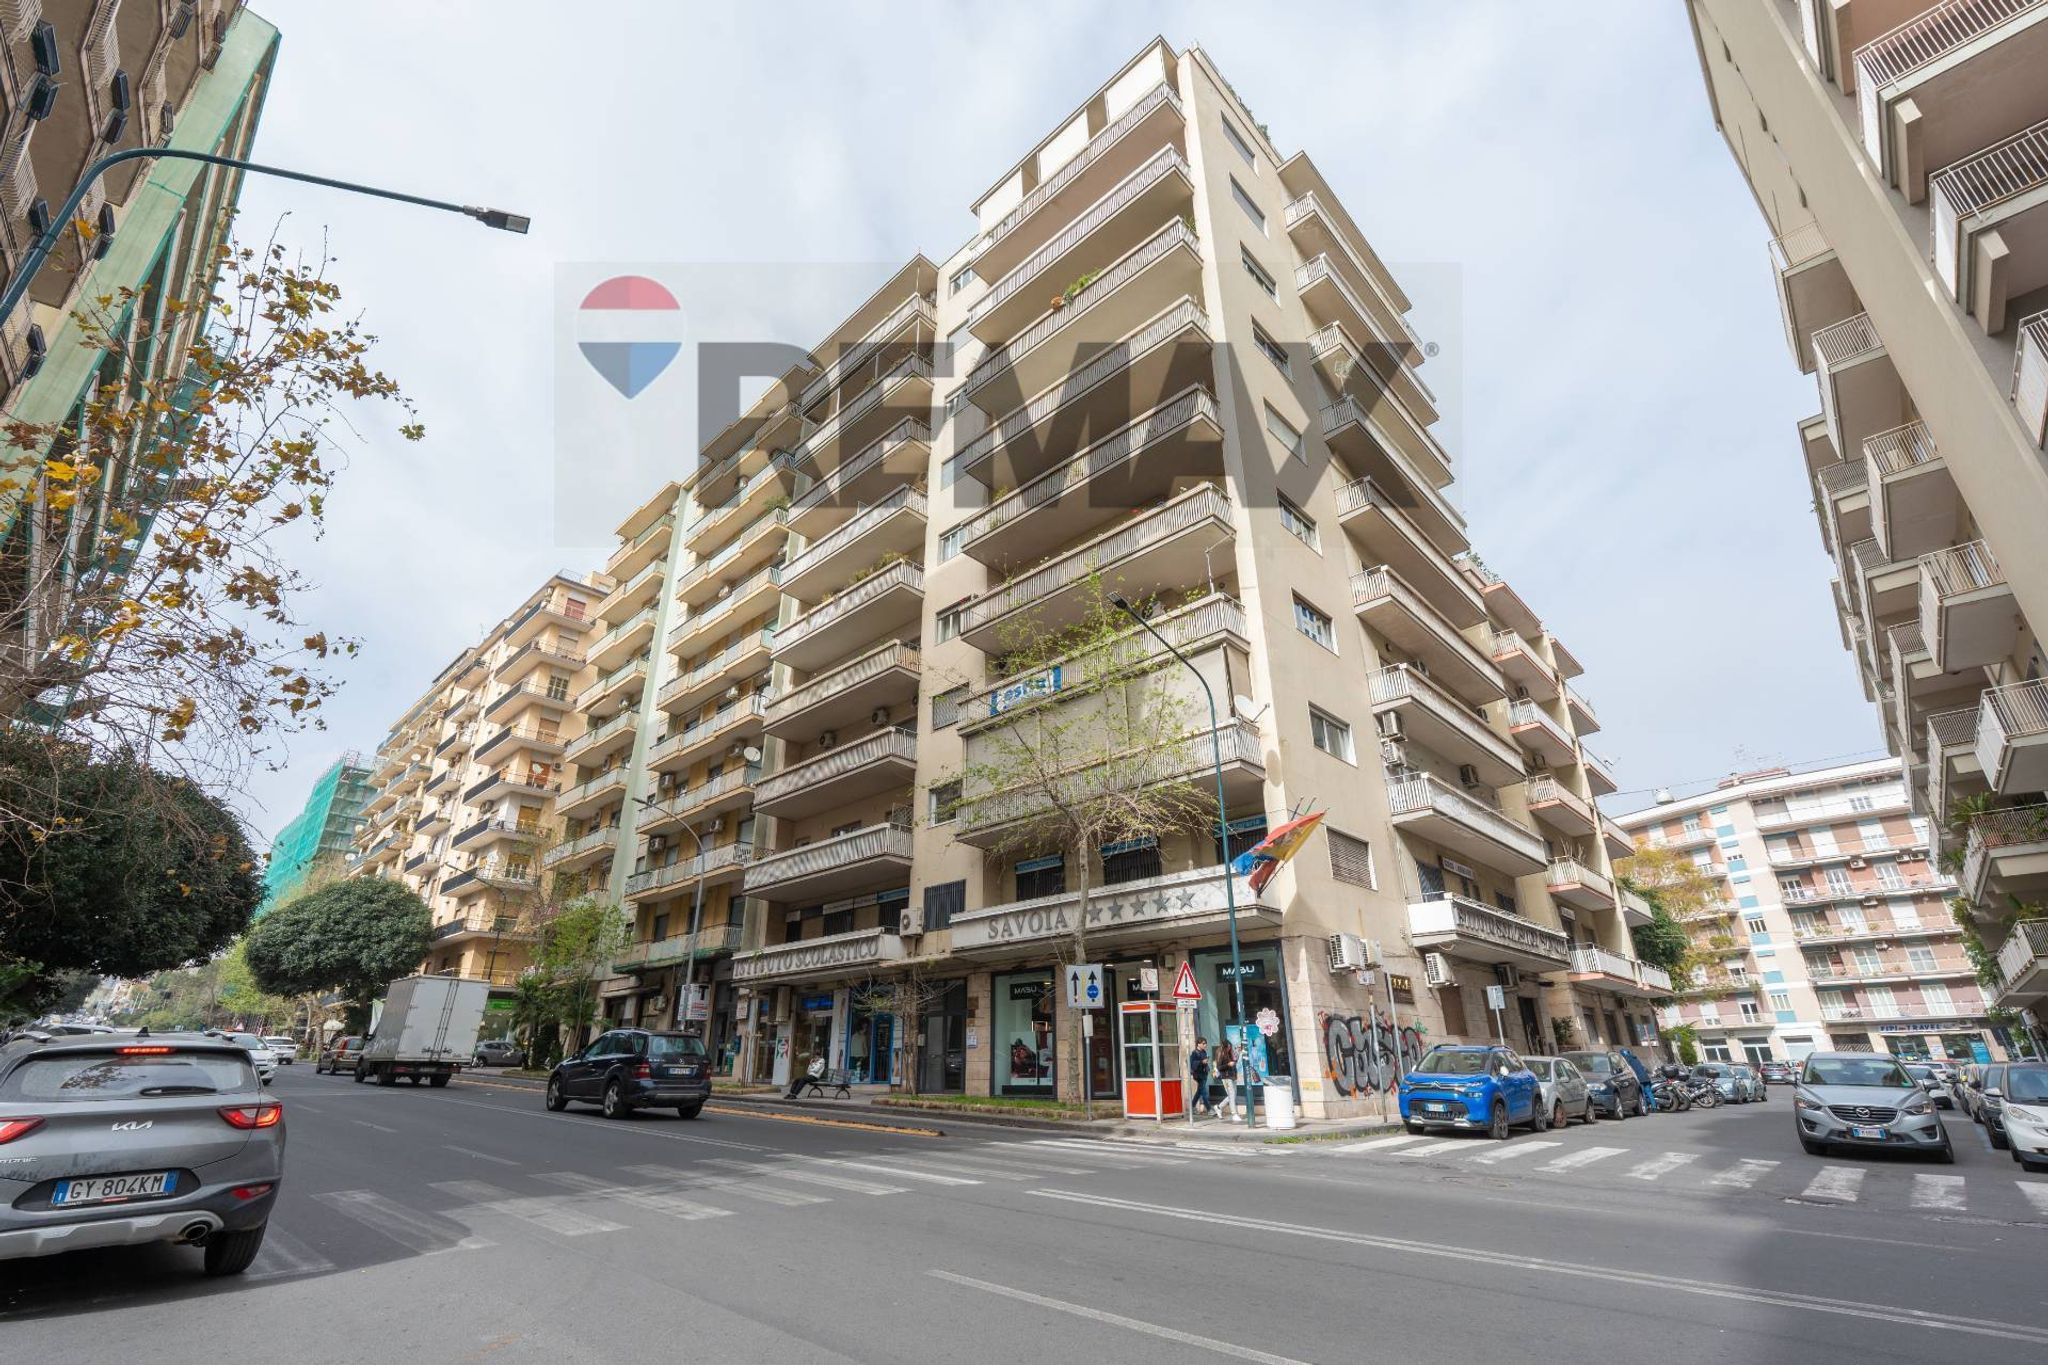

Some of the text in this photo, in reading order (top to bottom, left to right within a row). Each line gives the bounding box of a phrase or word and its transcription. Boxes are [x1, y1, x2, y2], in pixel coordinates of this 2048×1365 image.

[987, 905, 1068, 940] SAVOIA
[734, 934, 879, 977] ISTITUTO SCOLASTICO
[1907, 1023, 1940, 1031] TRAVEL
[111, 1120, 153, 1132] KIA
[70, 1180, 96, 1199] GY
[101, 1175, 164, 1196] 804KM
